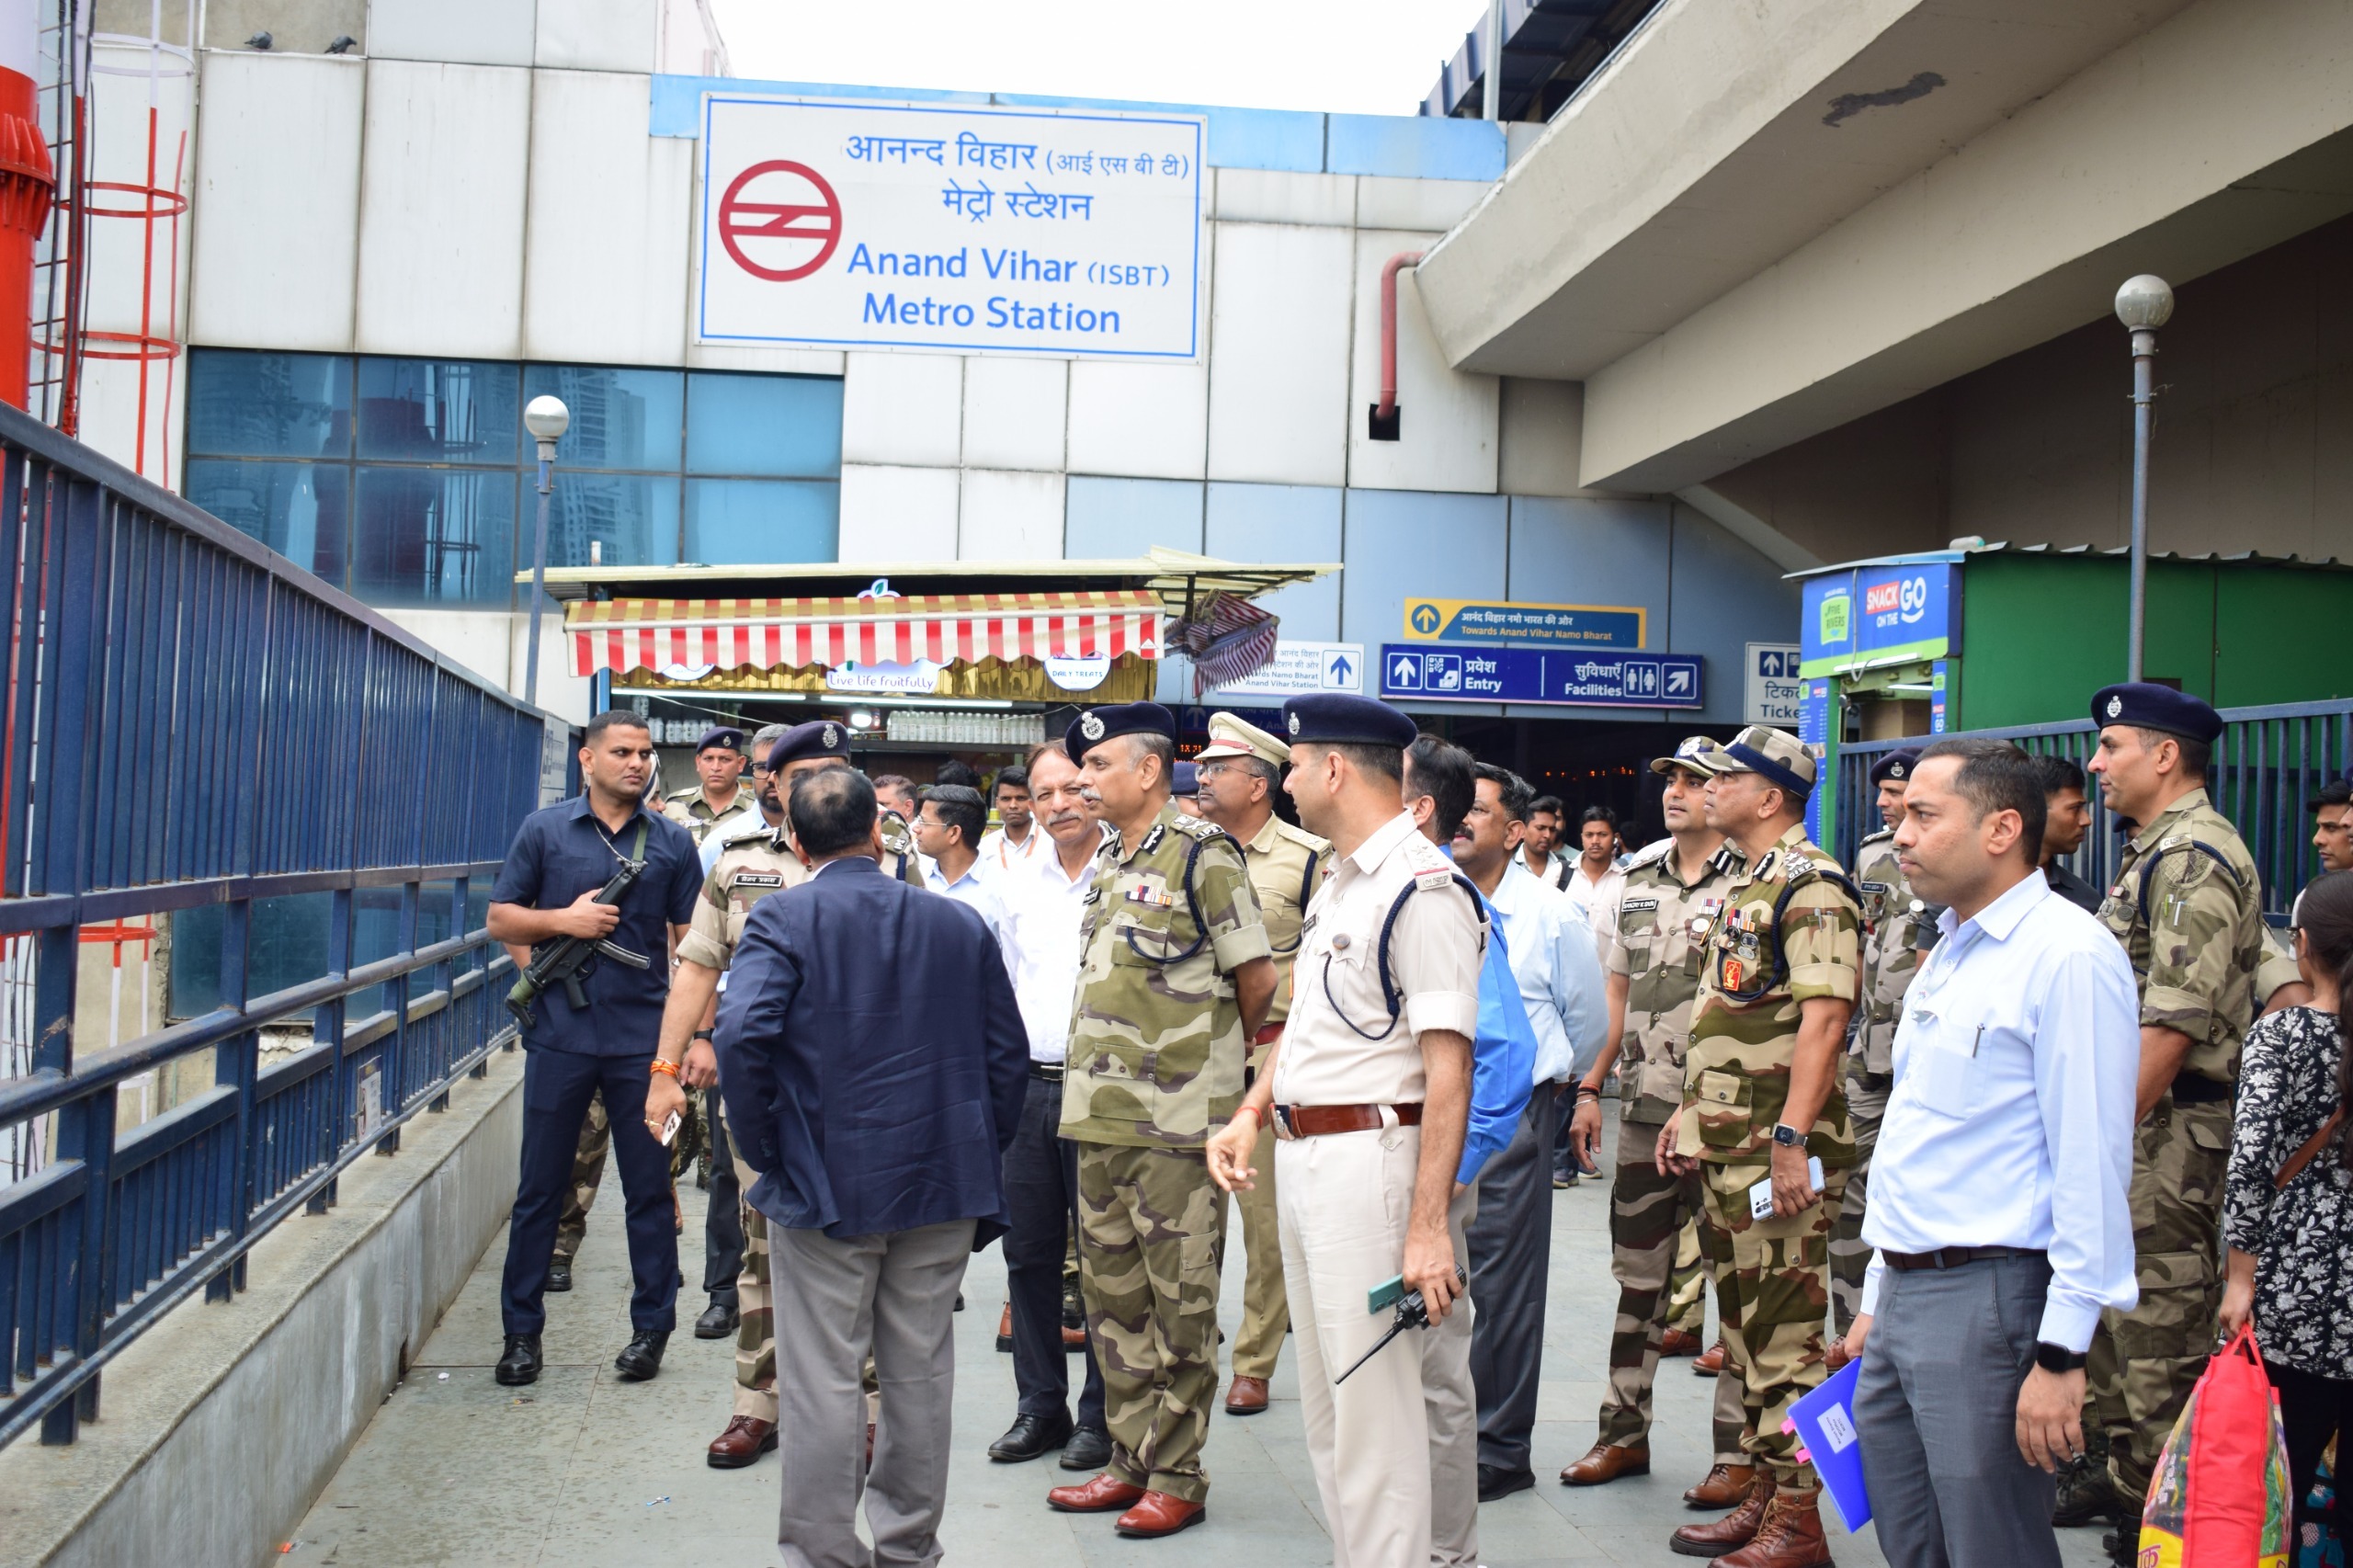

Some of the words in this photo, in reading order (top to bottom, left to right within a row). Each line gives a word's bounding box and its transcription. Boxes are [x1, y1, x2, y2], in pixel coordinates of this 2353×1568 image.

[847, 134, 946, 166] आनन्द
[957, 131, 1038, 171] विहार
[1046, 150, 1094, 176] (आई
[1099, 153, 1129, 176] एस
[1134, 152, 1154, 176] बी
[1161, 153, 1190, 178] टी)
[942, 178, 995, 222] मेट्रो
[1005, 181, 1094, 222] स्टेशन
[847, 242, 968, 278] Anand
[981, 247, 1078, 283] Vihar
[1087, 261, 1170, 287] (ISBT)
[862, 291, 975, 329] Metro
[986, 296, 1120, 334] Station
[1867, 585, 1898, 610] SNACK
[1901, 576, 1926, 611] GO
[1461, 611, 1483, 623] आनंद
[1484, 610, 1506, 624] विहार
[1507, 612, 1522, 624] नमो
[1523, 613, 1543, 626] भारत
[1544, 612, 1557, 626] की
[1558, 614, 1573, 626] ओर
[1461, 626, 1497, 637] Towards
[1499, 628, 1528, 638] Anand
[1529, 629, 1553, 639] Vihar
[1555, 631, 1581, 640] Namo
[1583, 631, 1612, 641] Bharat
[1465, 655, 1497, 674] प्रवेश
[1574, 662, 1622, 681] सुविधाएँ
[829, 676, 855, 687] Live
[857, 676, 878, 687] life
[880, 676, 935, 690] fruitfully
[1271, 671, 1293, 679] Namo
[1294, 672, 1318, 680] Bharat
[1464, 676, 1502, 692] Entry
[1564, 682, 1622, 697] Facilities
[1760, 704, 1799, 718] Ticke
[1198, 825, 1220, 837] IPS
[2164, 835, 2184, 846] CISF
[1789, 862, 1814, 879] CISF
